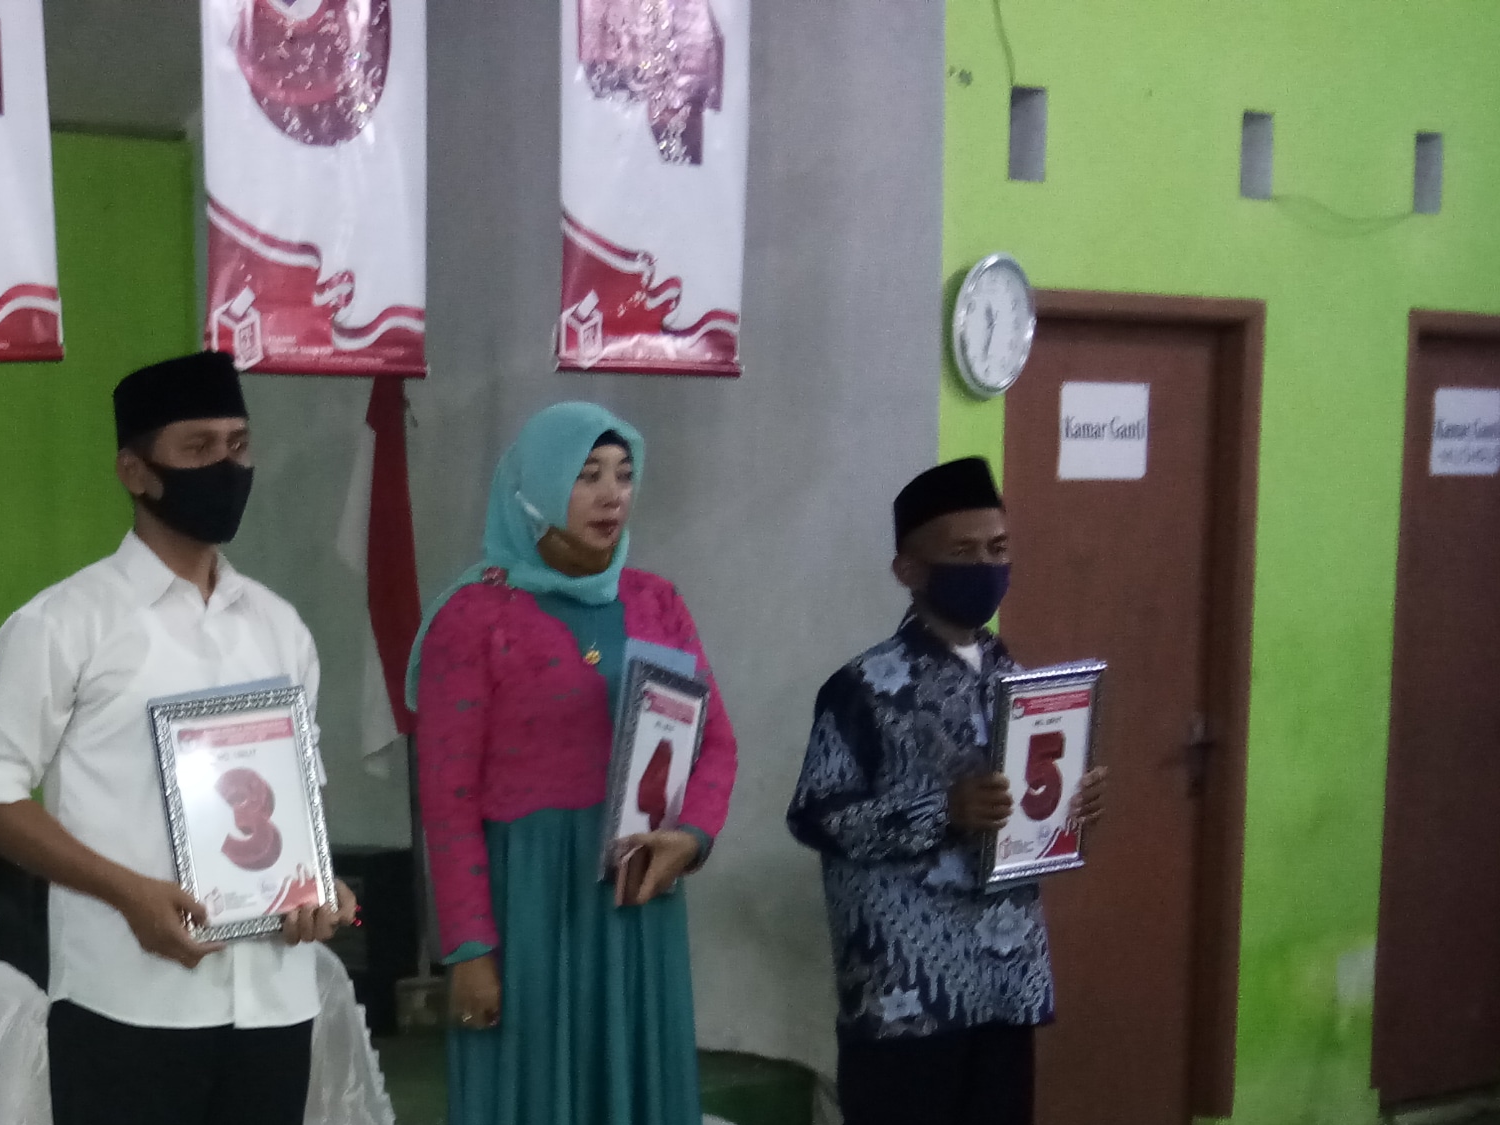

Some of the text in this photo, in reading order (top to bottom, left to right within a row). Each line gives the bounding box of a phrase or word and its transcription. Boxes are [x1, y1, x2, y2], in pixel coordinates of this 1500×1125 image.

[1065, 415, 1105, 440] Kamar
[216, 767, 283, 872] 3
[1020, 731, 1064, 822] 5
